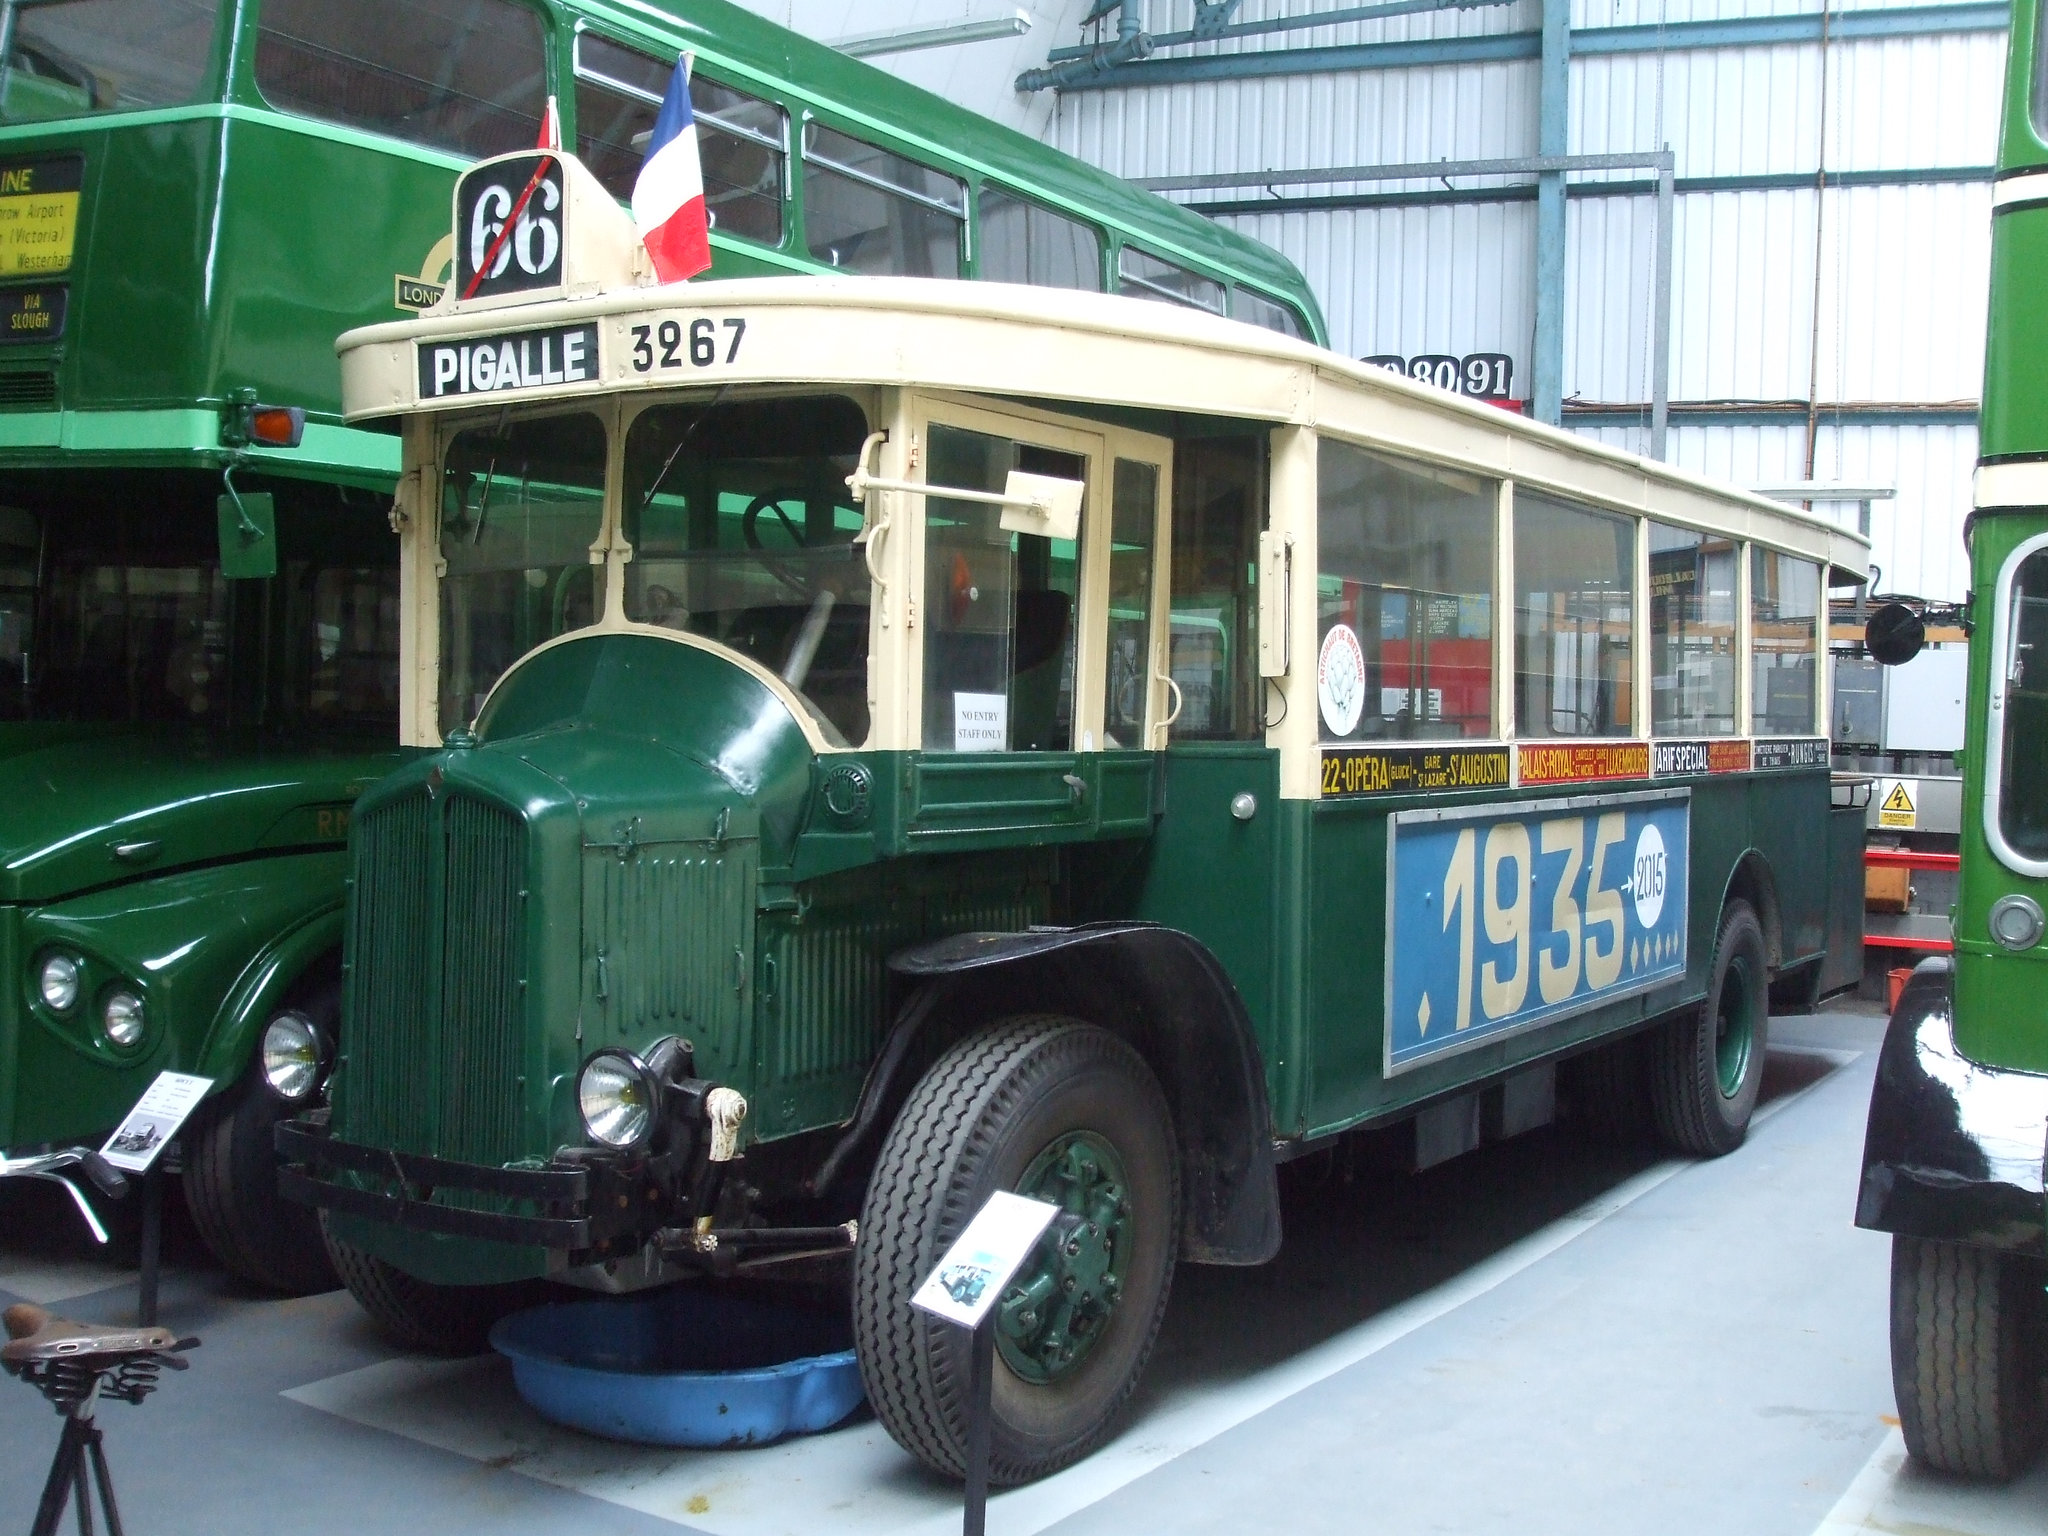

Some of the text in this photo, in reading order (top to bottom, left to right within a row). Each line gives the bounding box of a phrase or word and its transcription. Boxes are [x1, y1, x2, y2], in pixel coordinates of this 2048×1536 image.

[28, 204, 64, 224] Airport
[10, 226, 65, 244] (Victoria)
[471, 179, 559, 279] 66
[24, 294, 41, 309] VIA
[11, 312, 50, 330] SLOUGH
[631, 318, 746, 373] 3267
[434, 331, 586, 396] PIGALLE
[1466, 360, 1506, 395] 91
[962, 711, 999, 722] NO ENTRY
[958, 729, 1002, 739] STAFF ONLY
[1424, 756, 1441, 769] GARE
[1654, 747, 1674, 772] TARIF
[1675, 744, 1708, 771] SPÉCIAL
[1637, 852, 1663, 901] 2015
[1443, 811, 1626, 1031] 1935
